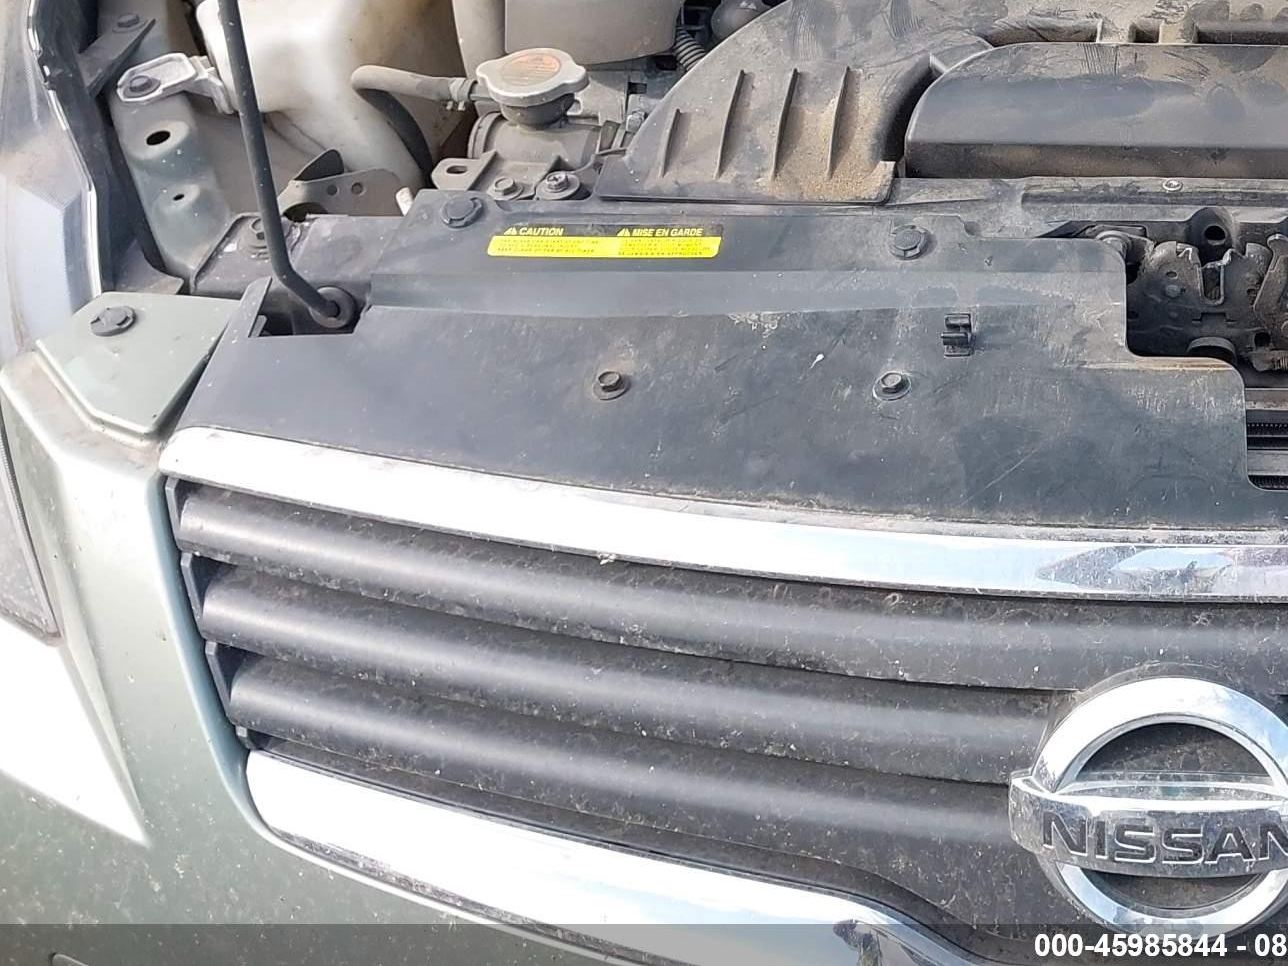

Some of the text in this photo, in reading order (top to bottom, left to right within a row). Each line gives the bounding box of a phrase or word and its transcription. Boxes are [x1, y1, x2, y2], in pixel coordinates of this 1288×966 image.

[520, 227, 564, 236] CAUTION
[632, 228, 704, 237] MISE EN GARDE
